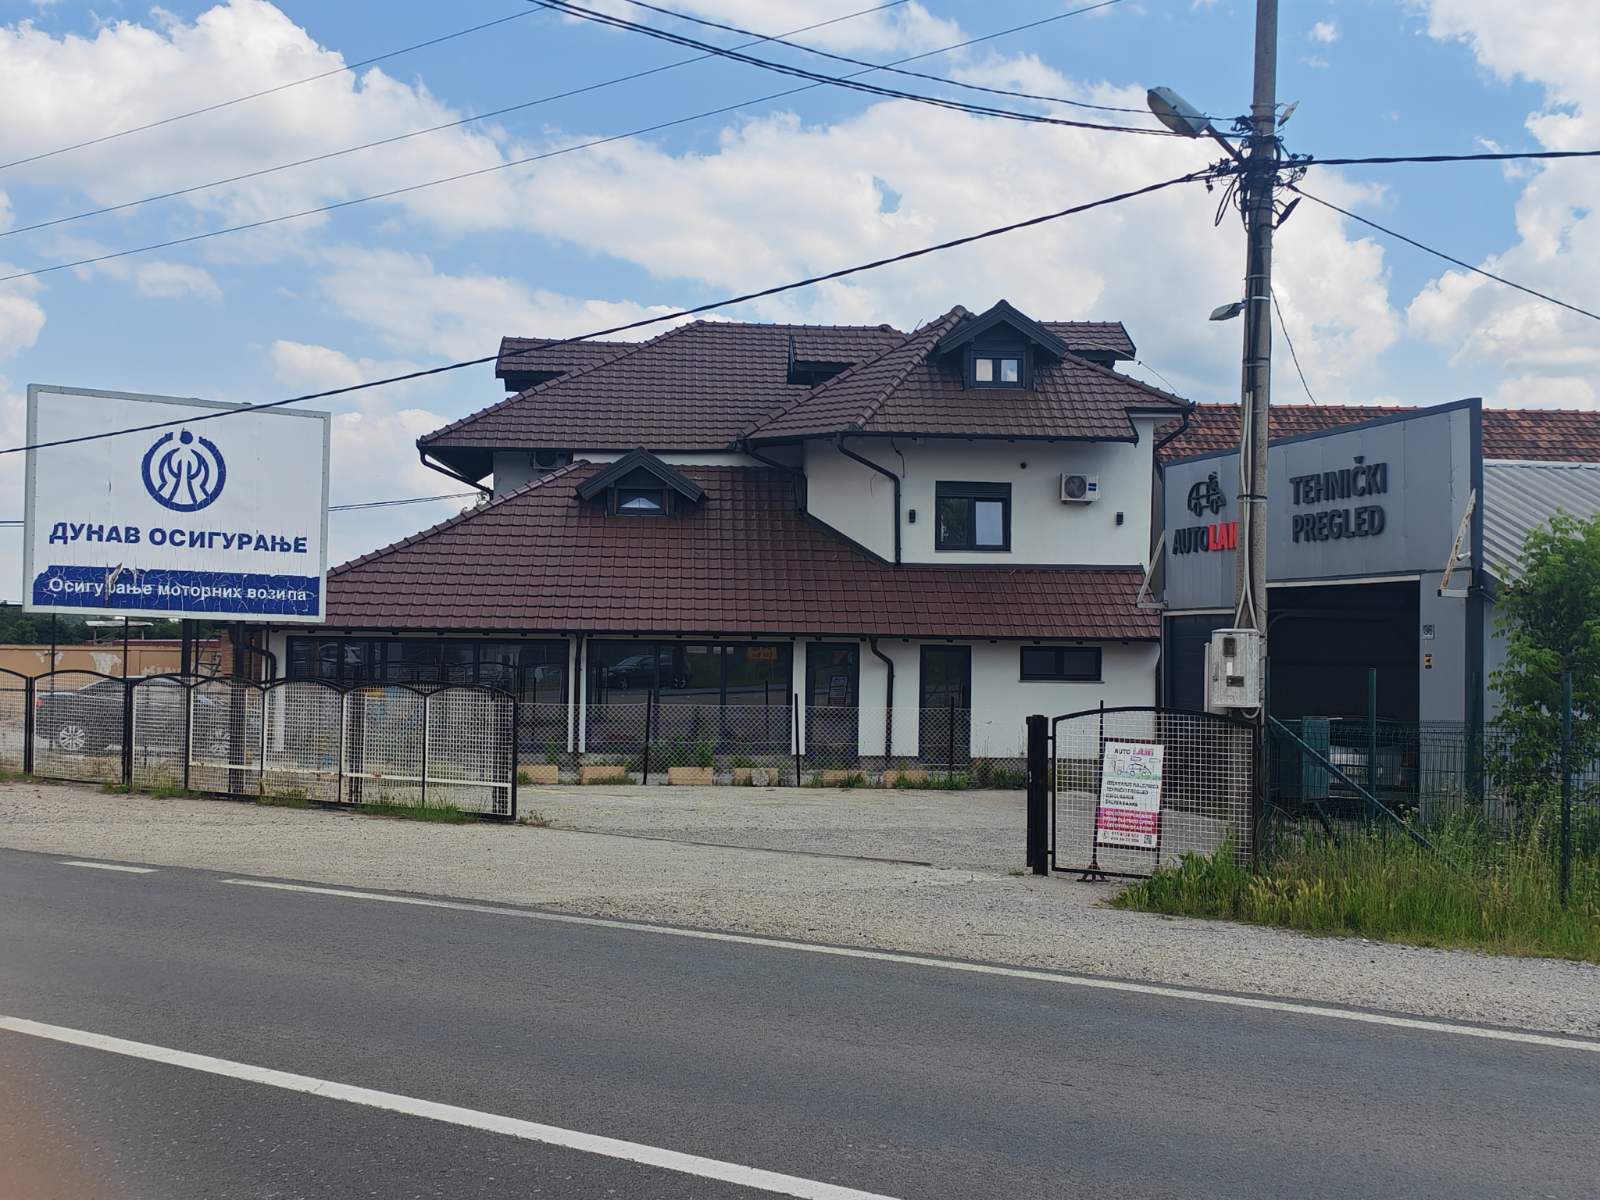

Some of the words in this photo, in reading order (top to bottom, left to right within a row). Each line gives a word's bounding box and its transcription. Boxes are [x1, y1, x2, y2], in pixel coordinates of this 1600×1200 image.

[1289, 456, 1388, 505] TEHNIČKI
[49, 522, 141, 544] ДУНАВ
[148, 527, 307, 553] ОСИГУРАЊЕ
[1292, 504, 1385, 543] PREGLED
[158, 585, 242, 600] моторних
[247, 588, 306, 601] возила
